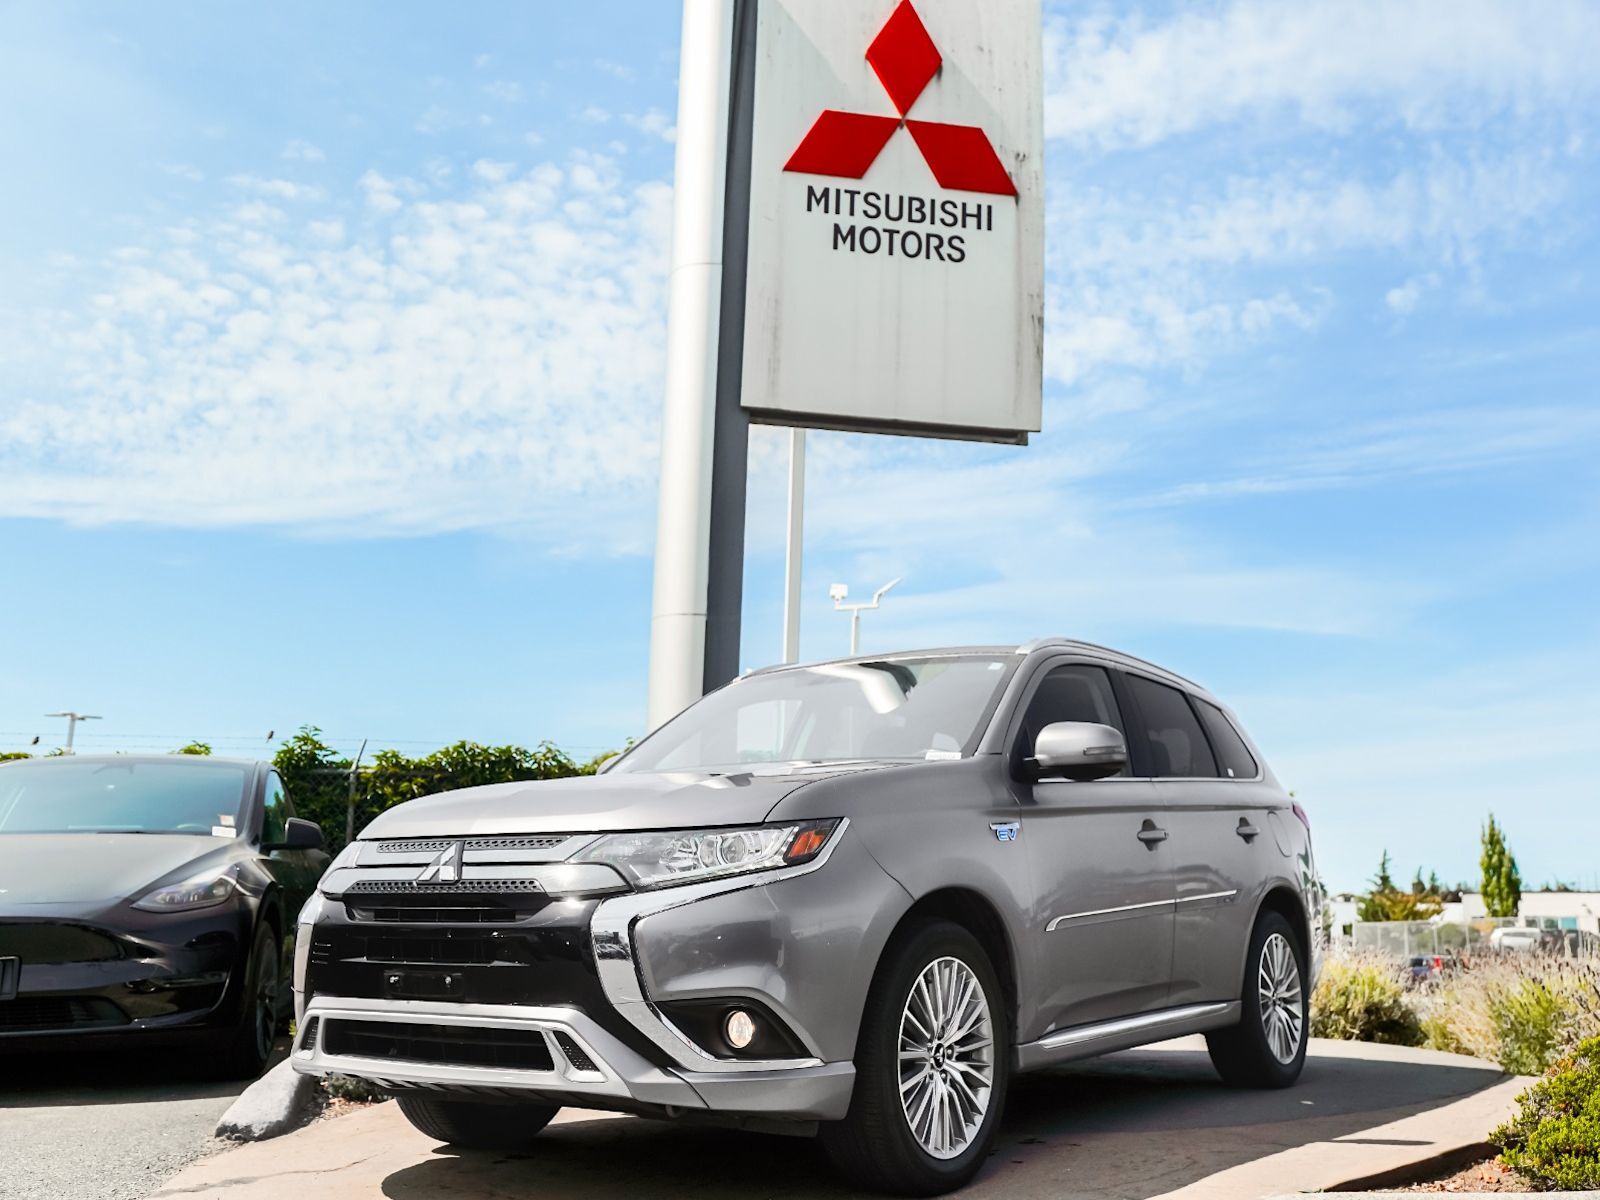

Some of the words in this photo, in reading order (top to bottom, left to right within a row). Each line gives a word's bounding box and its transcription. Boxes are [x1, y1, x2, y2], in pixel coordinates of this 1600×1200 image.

[806, 185, 993, 231] MITSUBISHI
[832, 223, 966, 263] MOTORS
[994, 826, 1018, 841] EV
